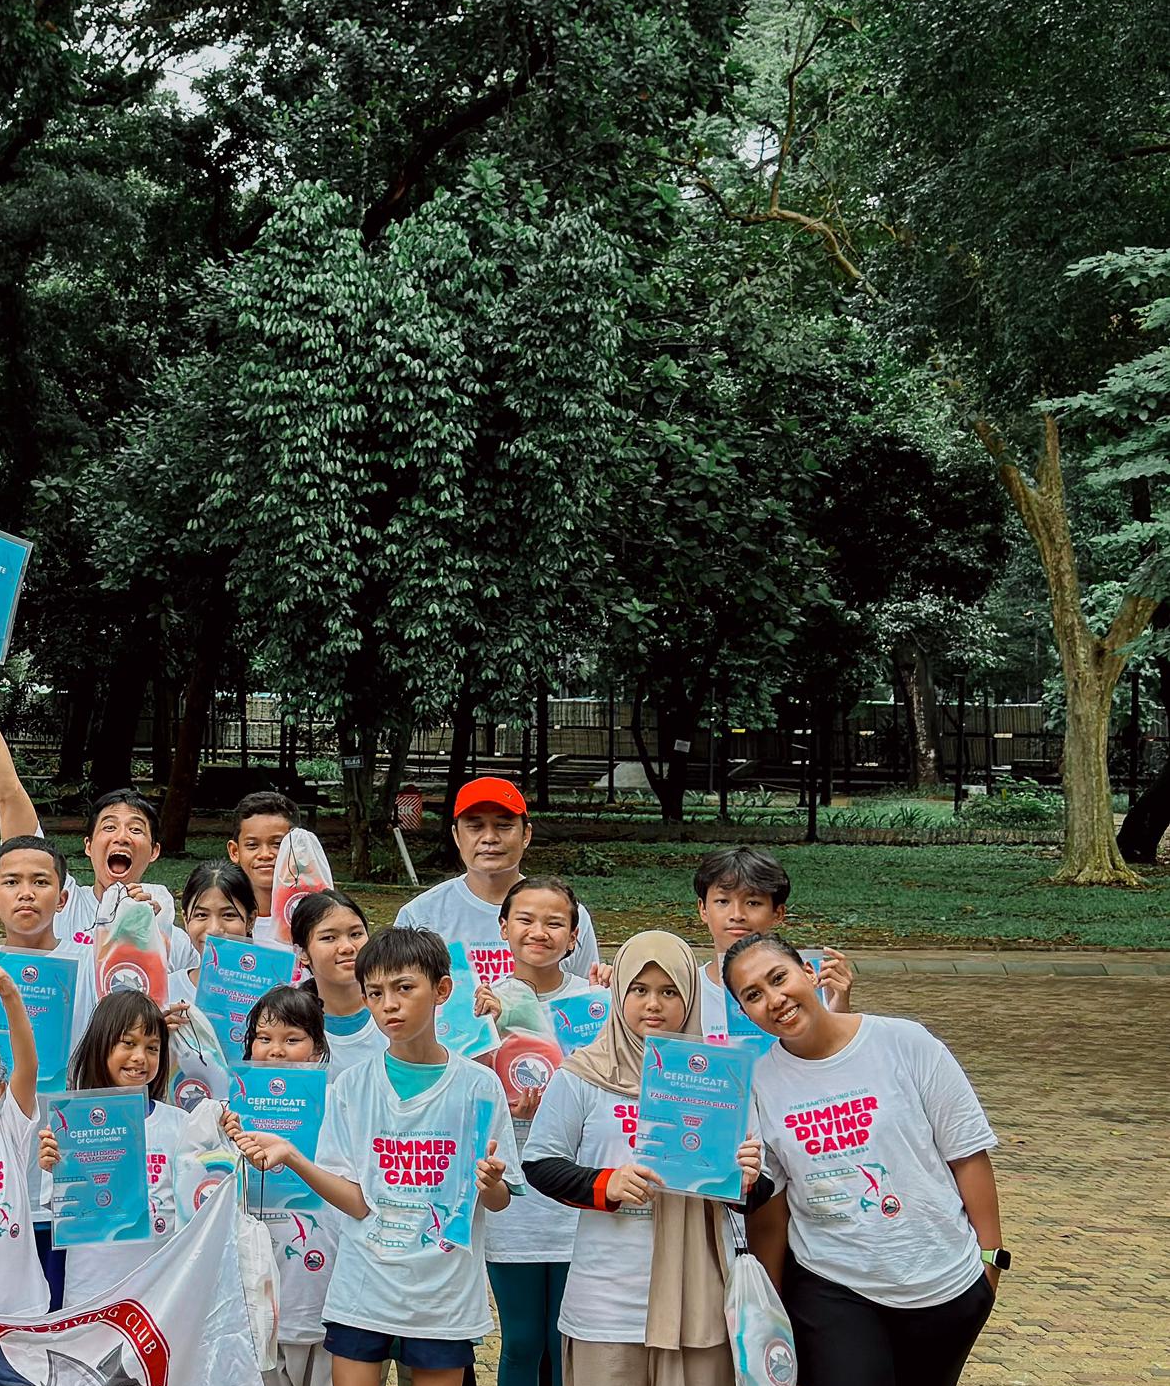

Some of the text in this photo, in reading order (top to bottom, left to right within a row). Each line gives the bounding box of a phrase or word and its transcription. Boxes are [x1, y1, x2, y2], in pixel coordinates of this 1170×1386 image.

[218, 968, 273, 985] CERTIFICATE
[664, 1071, 731, 1088] CERTIFICATE
[247, 1097, 307, 1107] CERTIFICATE
[784, 1096, 879, 1128] SUMMER
[69, 1126, 127, 1139] CERTIFICATE
[795, 1112, 873, 1141] DIVING
[372, 1137, 457, 1155] SUMMER
[805, 1129, 870, 1155] CAMP
[379, 1153, 450, 1170] DIVING
[384, 1170, 445, 1186] CAMP
[124, 1312, 157, 1355] CLUB
